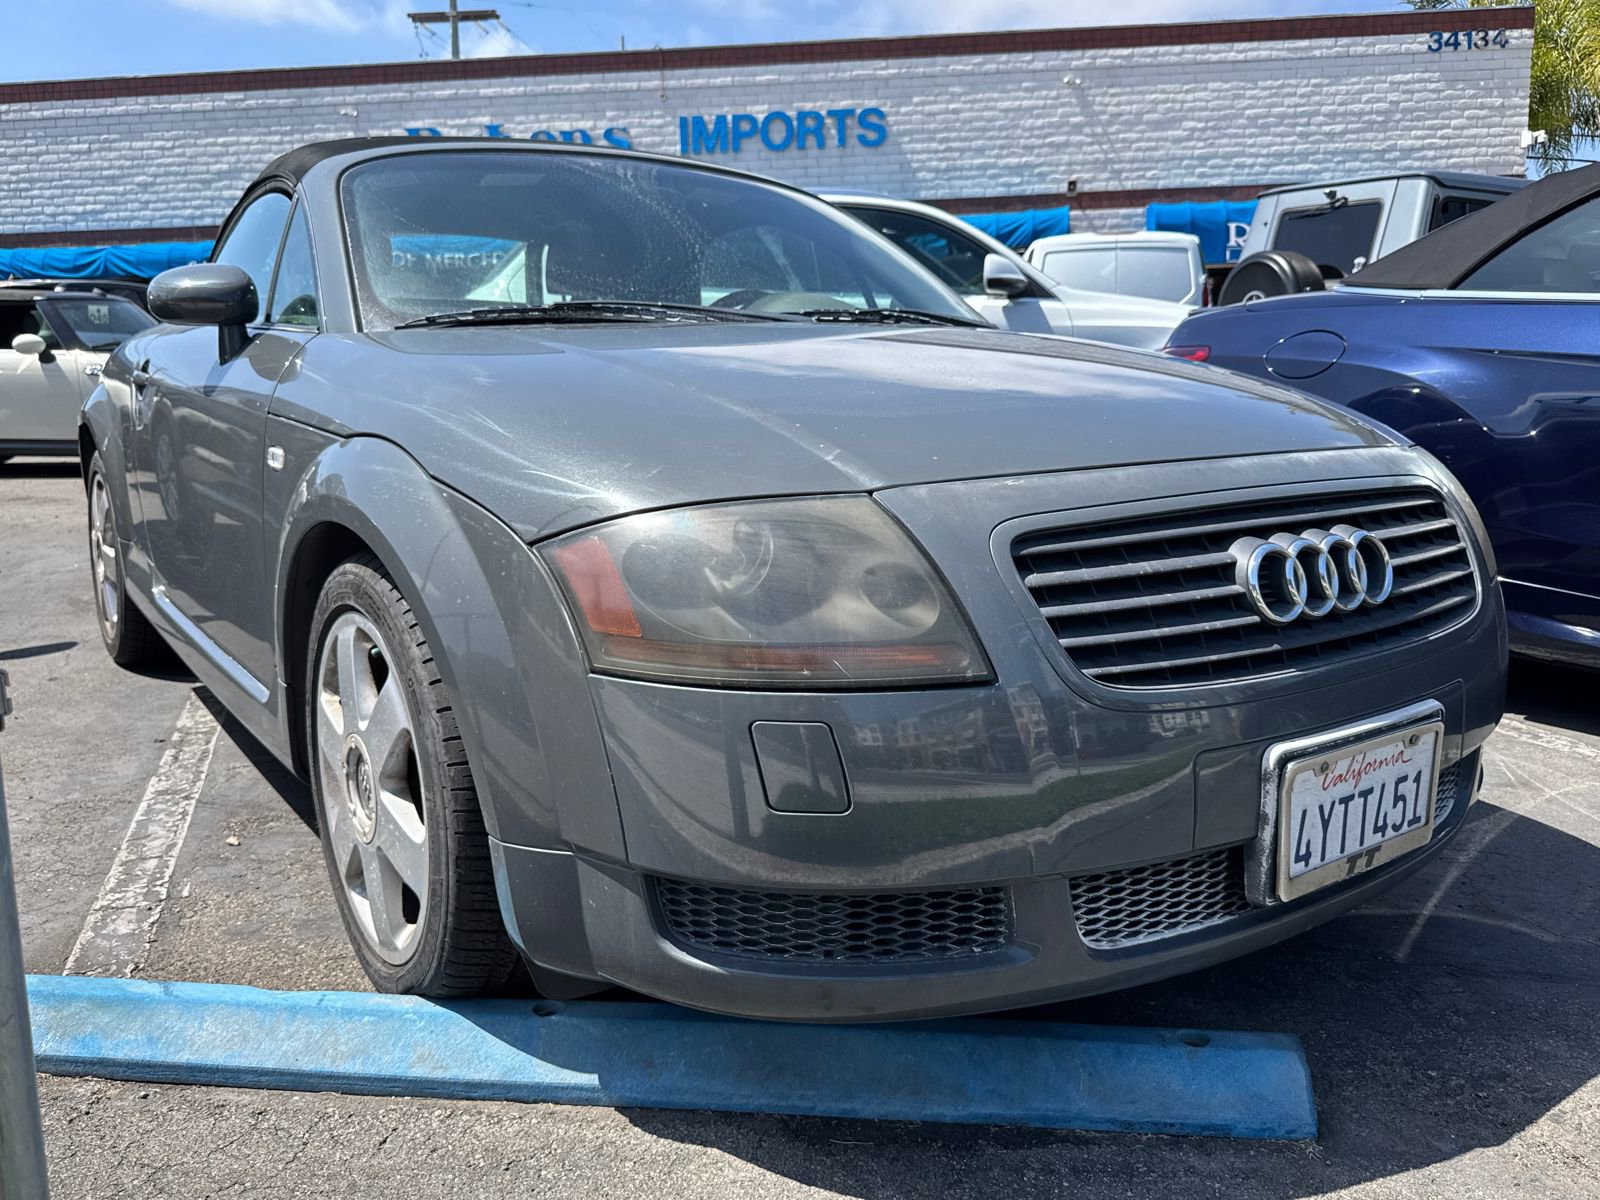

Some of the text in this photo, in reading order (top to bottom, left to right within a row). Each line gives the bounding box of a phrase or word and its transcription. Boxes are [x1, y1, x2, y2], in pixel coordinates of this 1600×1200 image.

[1427, 28, 1509, 53] 34134
[679, 107, 888, 155] IMPORTS
[1322, 746, 1413, 791] California
[1293, 769, 1423, 868] 4YTT451
[1345, 844, 1383, 878] TT
